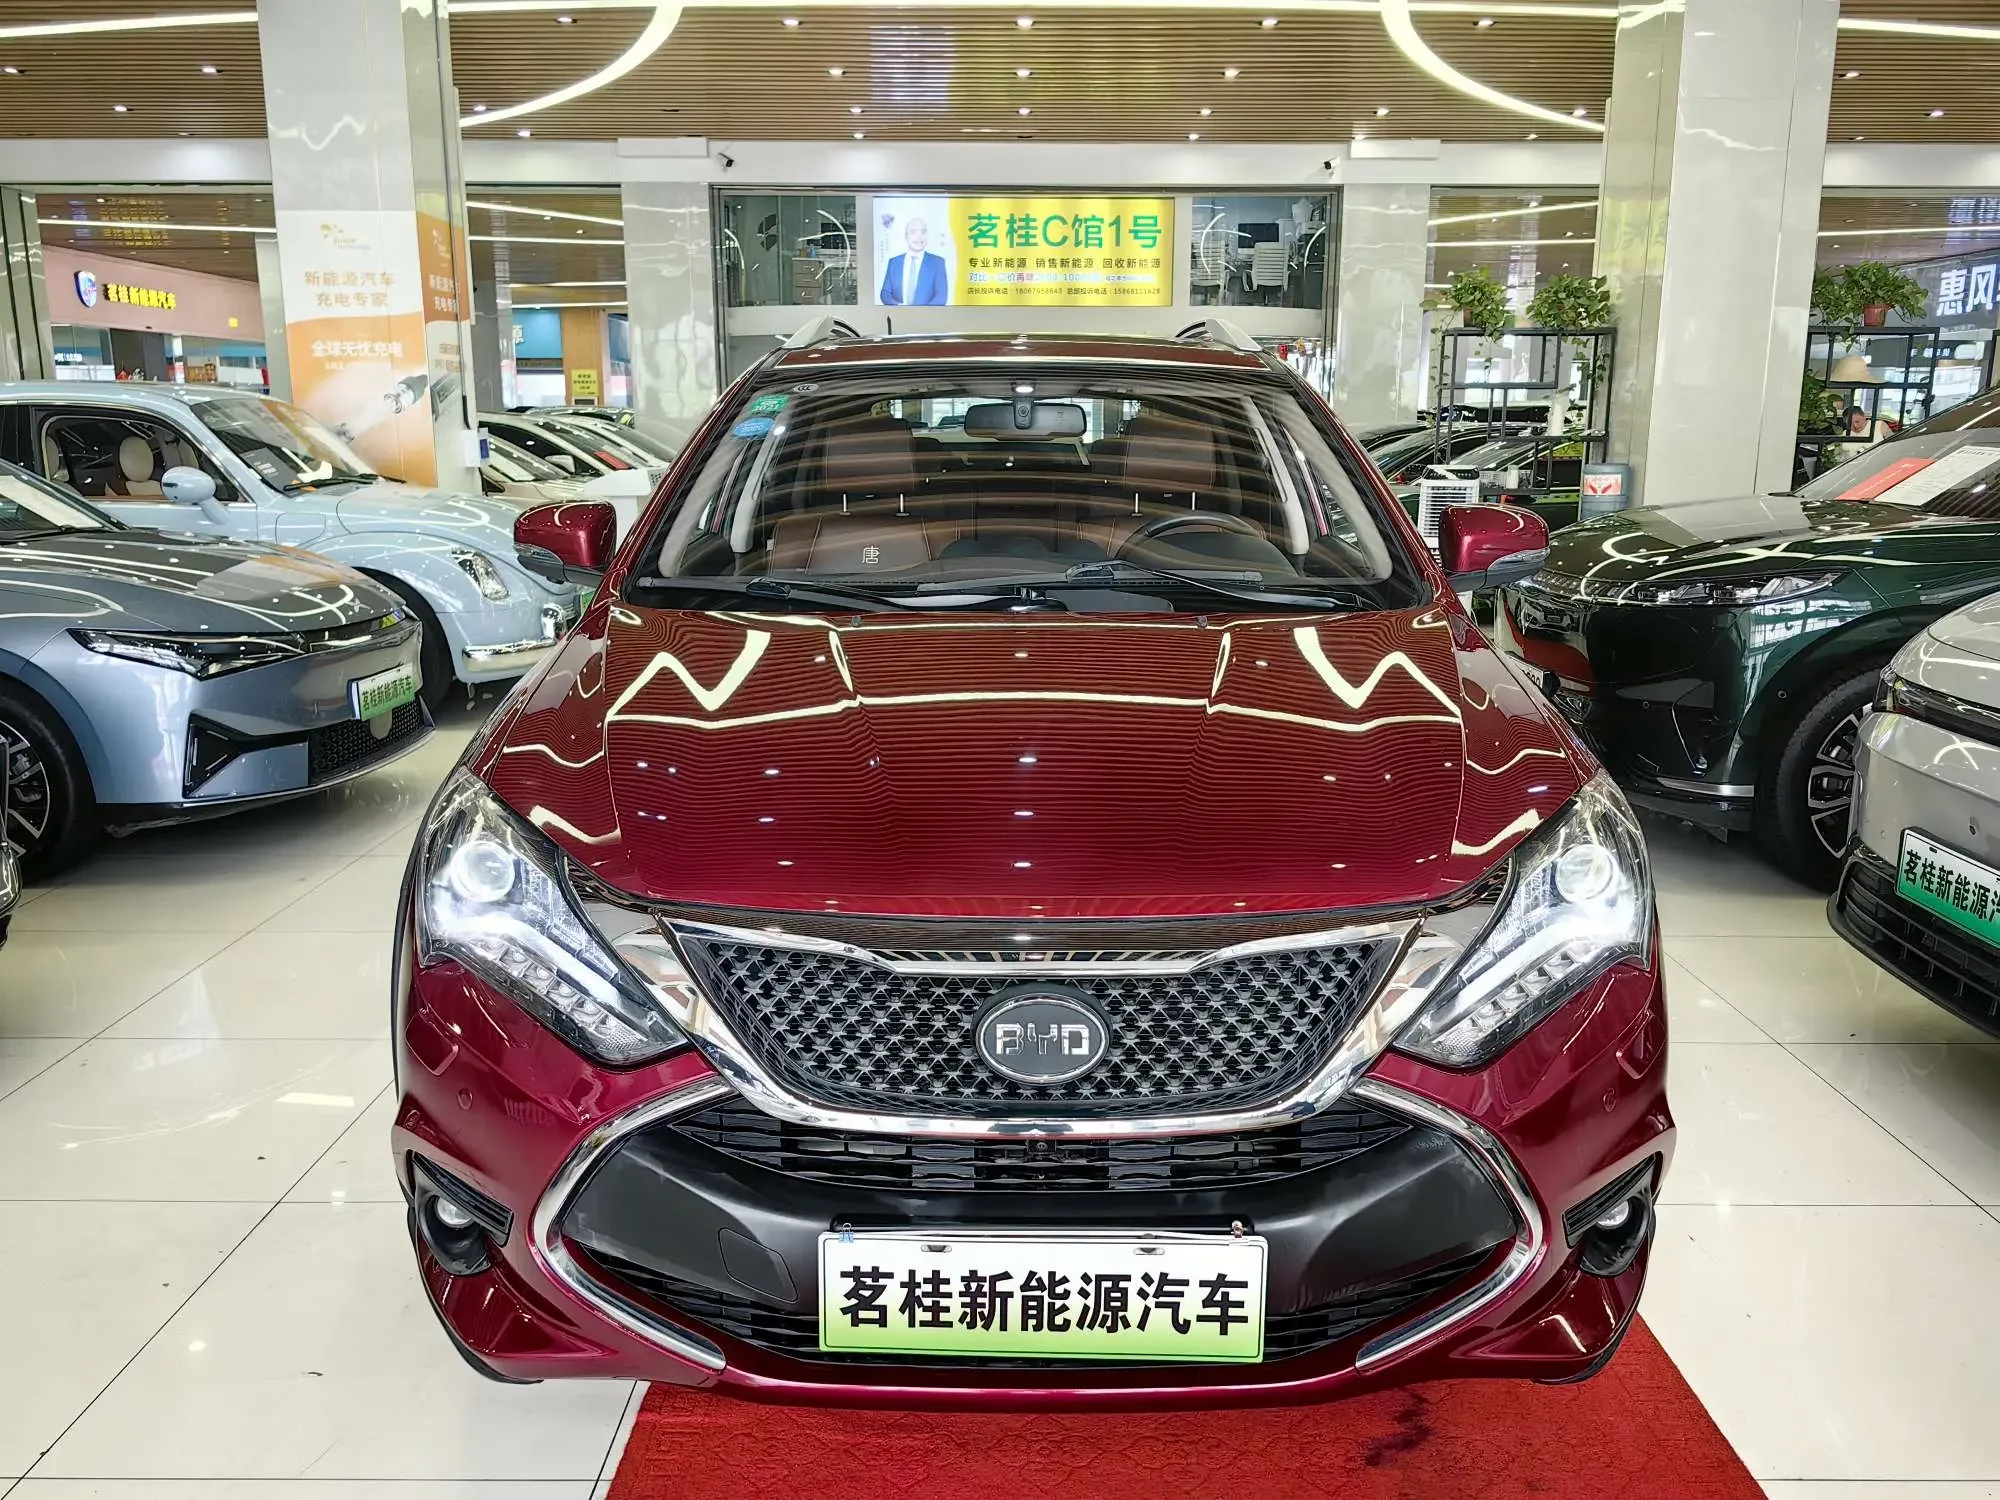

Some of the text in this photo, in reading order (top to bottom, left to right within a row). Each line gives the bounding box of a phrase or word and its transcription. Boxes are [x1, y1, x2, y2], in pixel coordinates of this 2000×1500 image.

[967, 213, 1162, 249] 茗桂C馆1号
[968, 257, 1161, 269] 专业新能源 销售新能源 回收新能源
[304, 271, 396, 287] 新能源汽车
[1936, 264, 2000, 317] 惠风
[315, 292, 389, 308] 充电专家
[311, 340, 403, 358] 全球无忧充电
[862, 545, 880, 564] 唐
[361, 675, 412, 711] 茗桂新能源汽车
[996, 1022, 1090, 1056] BYD
[840, 1265, 1249, 1336] 茗桂新能源汽车
